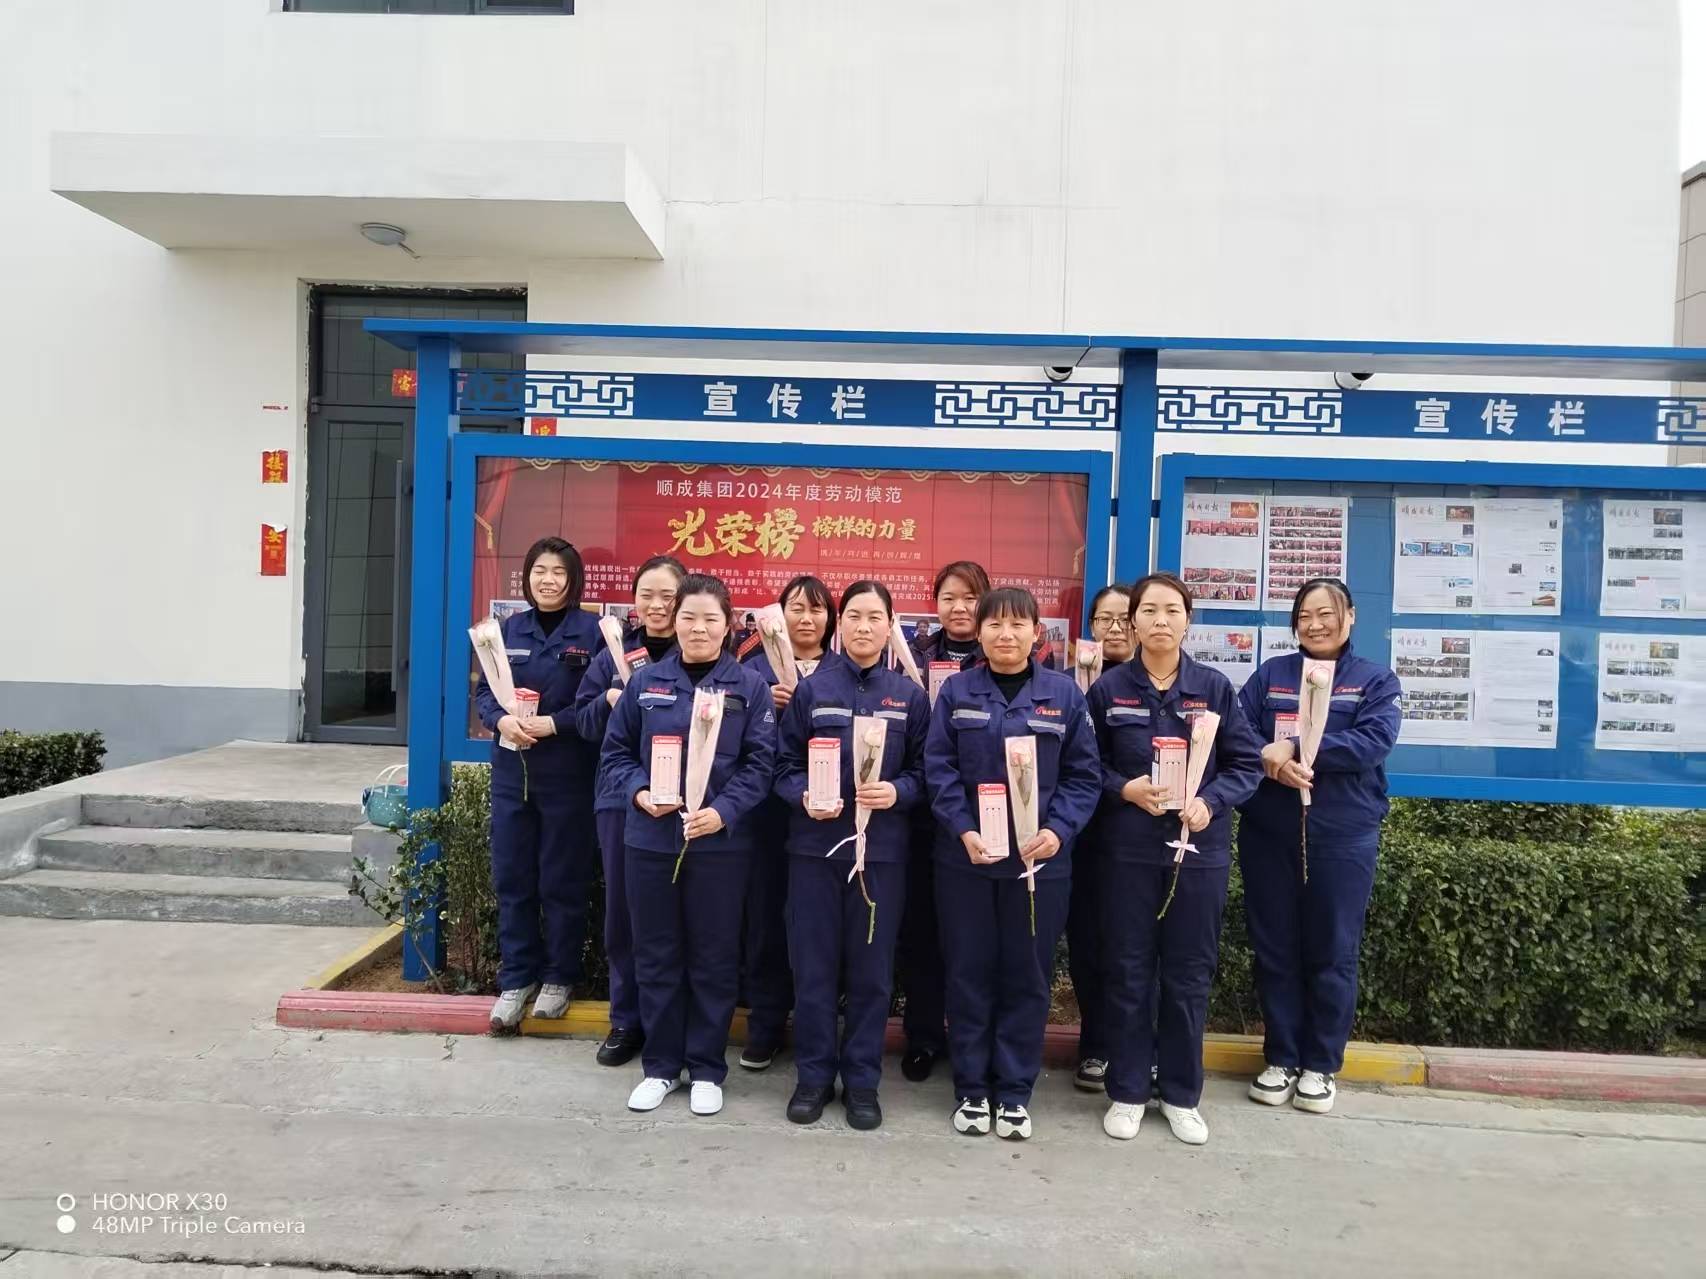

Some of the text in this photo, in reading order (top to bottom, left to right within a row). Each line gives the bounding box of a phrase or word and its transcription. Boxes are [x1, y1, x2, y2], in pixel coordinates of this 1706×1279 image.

[703, 382, 866, 420] 宣传栏
[1414, 398, 1586, 436] 宣传栏
[655, 479, 903, 504] 顺成集团2024年度劳动模范
[666, 506, 917, 561] 光荣榜 榜样的力量
